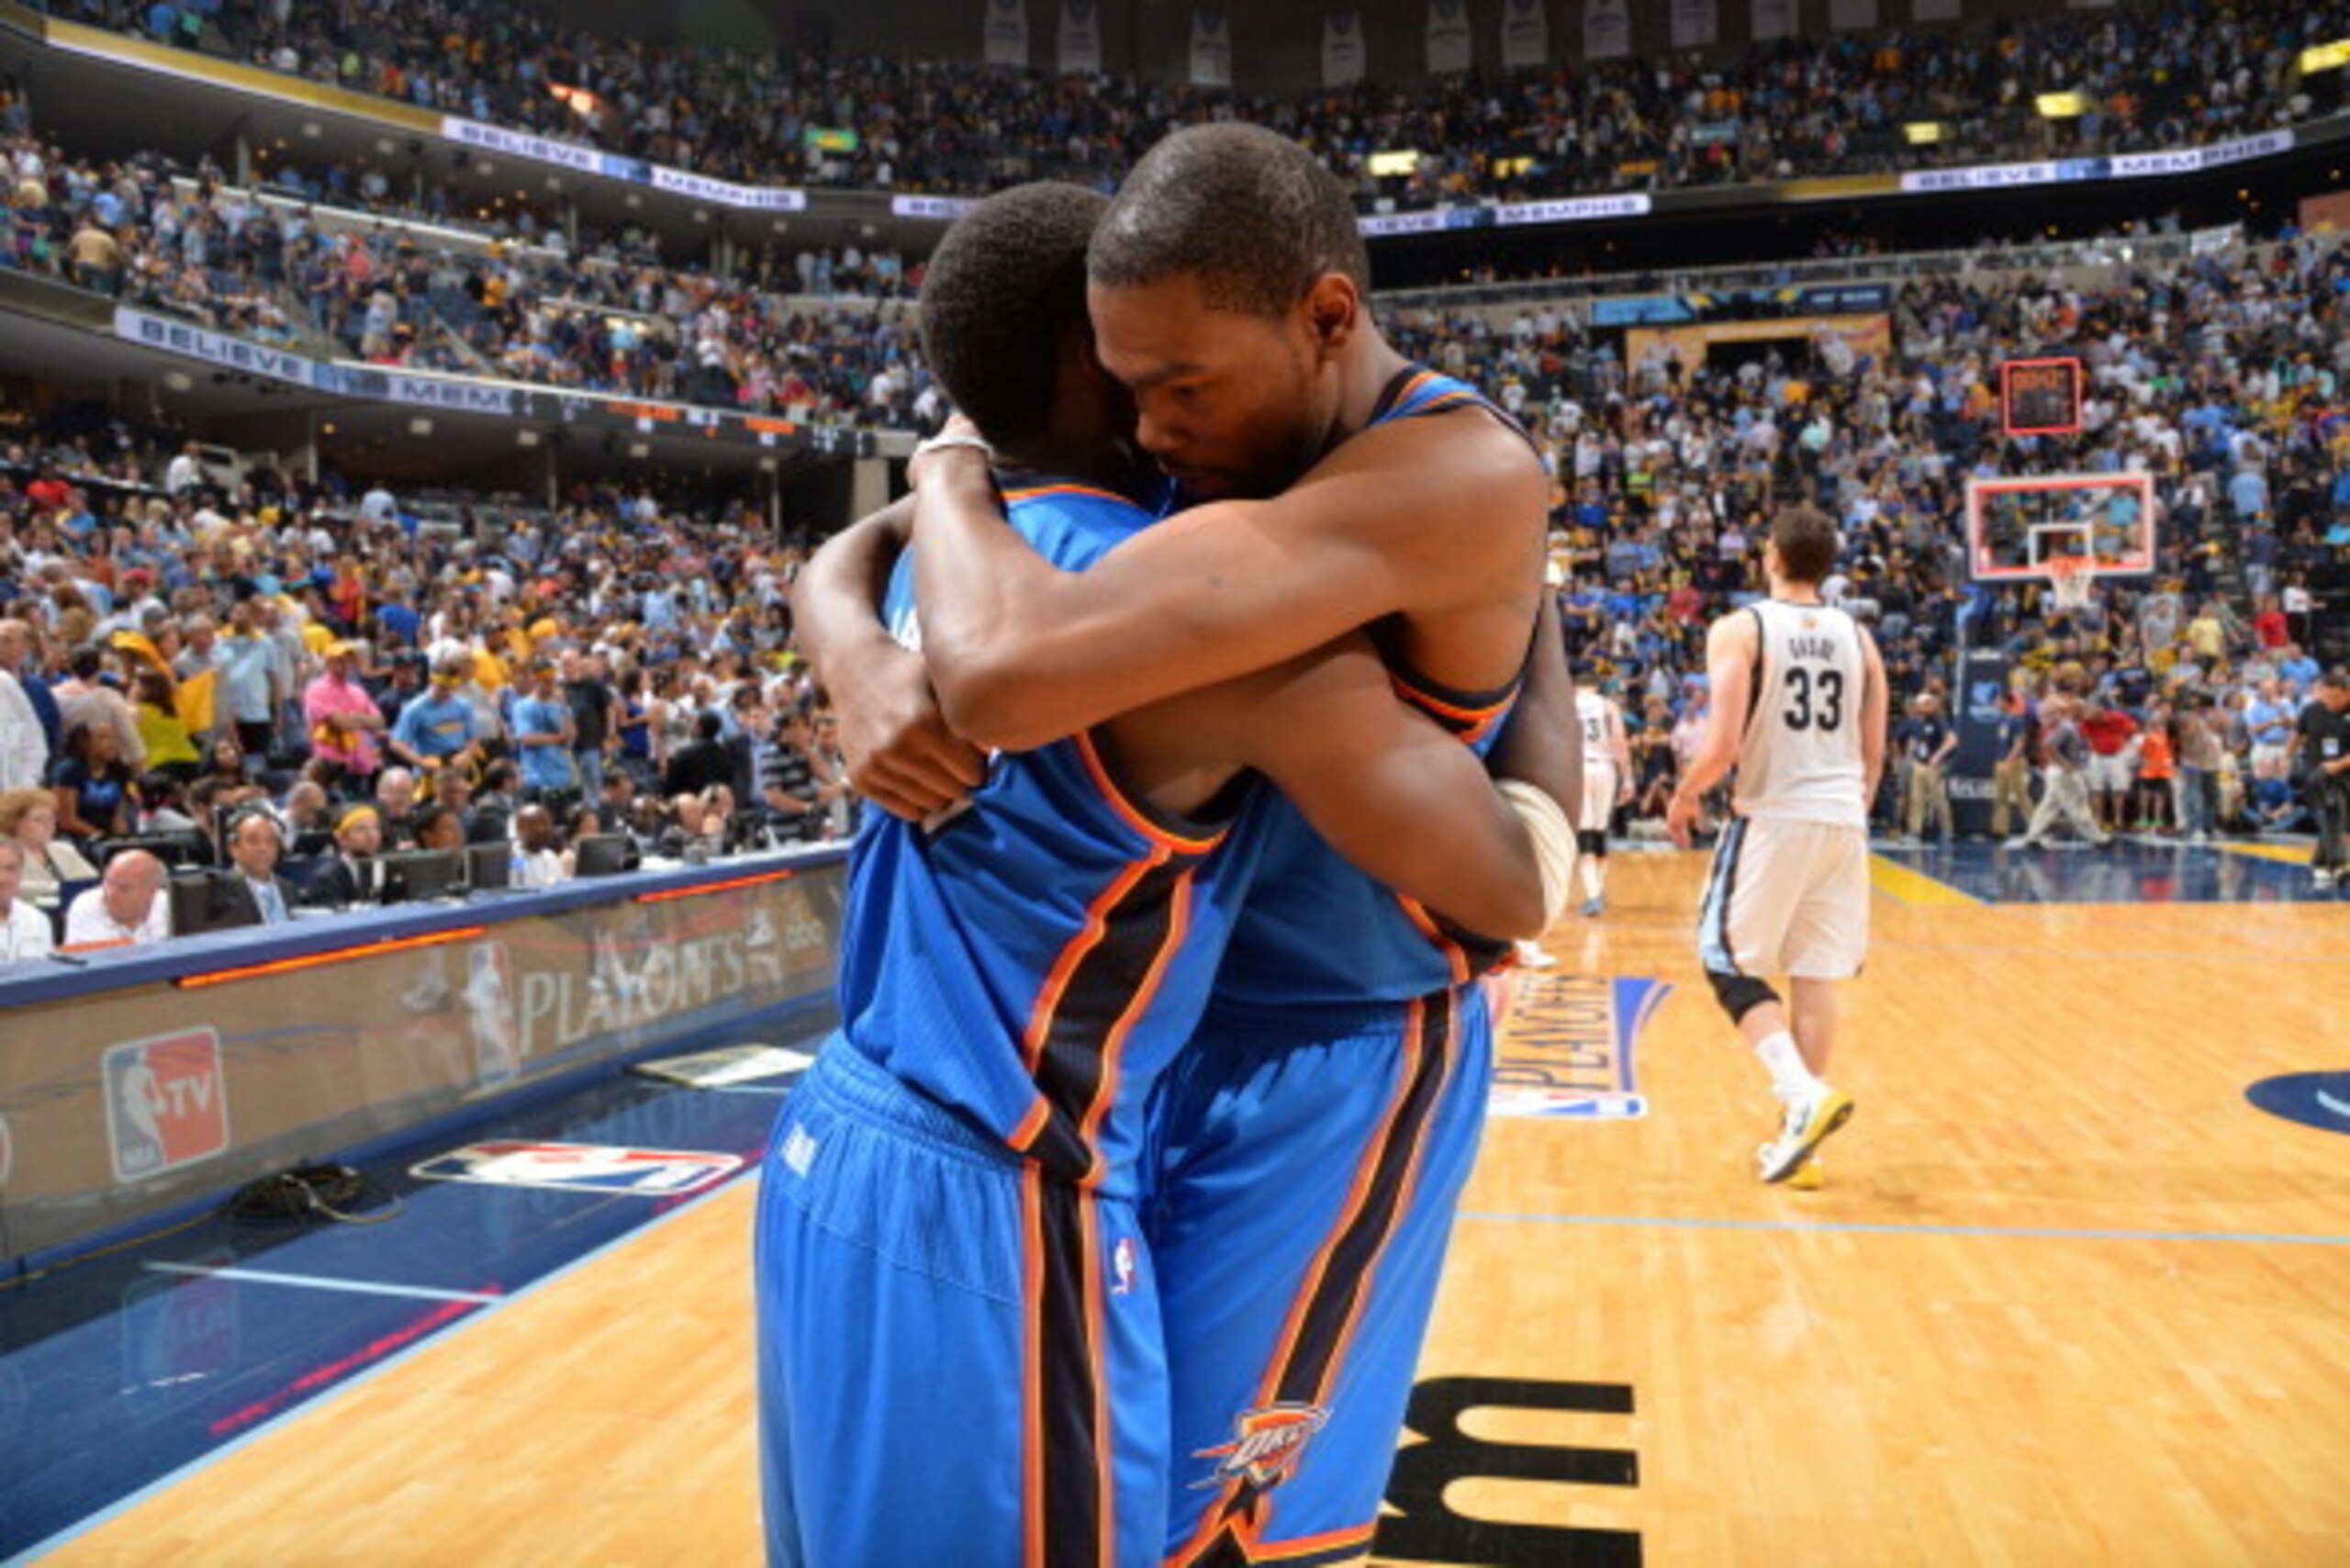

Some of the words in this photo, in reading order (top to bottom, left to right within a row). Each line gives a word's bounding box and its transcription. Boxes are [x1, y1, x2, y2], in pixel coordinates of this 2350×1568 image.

[460, 124, 592, 168] BELIEVE
[662, 172, 792, 207] MEMPHIS
[1919, 164, 2044, 189] BELIEVE
[2121, 137, 2277, 173] MEMPHIS
[1503, 196, 1637, 220] MEMPHIS
[140, 316, 302, 380] BELIEVE
[1783, 665, 1844, 734] 33
[520, 931, 748, 1056] PLAYOFFS
[165, 1070, 214, 1121] TV
